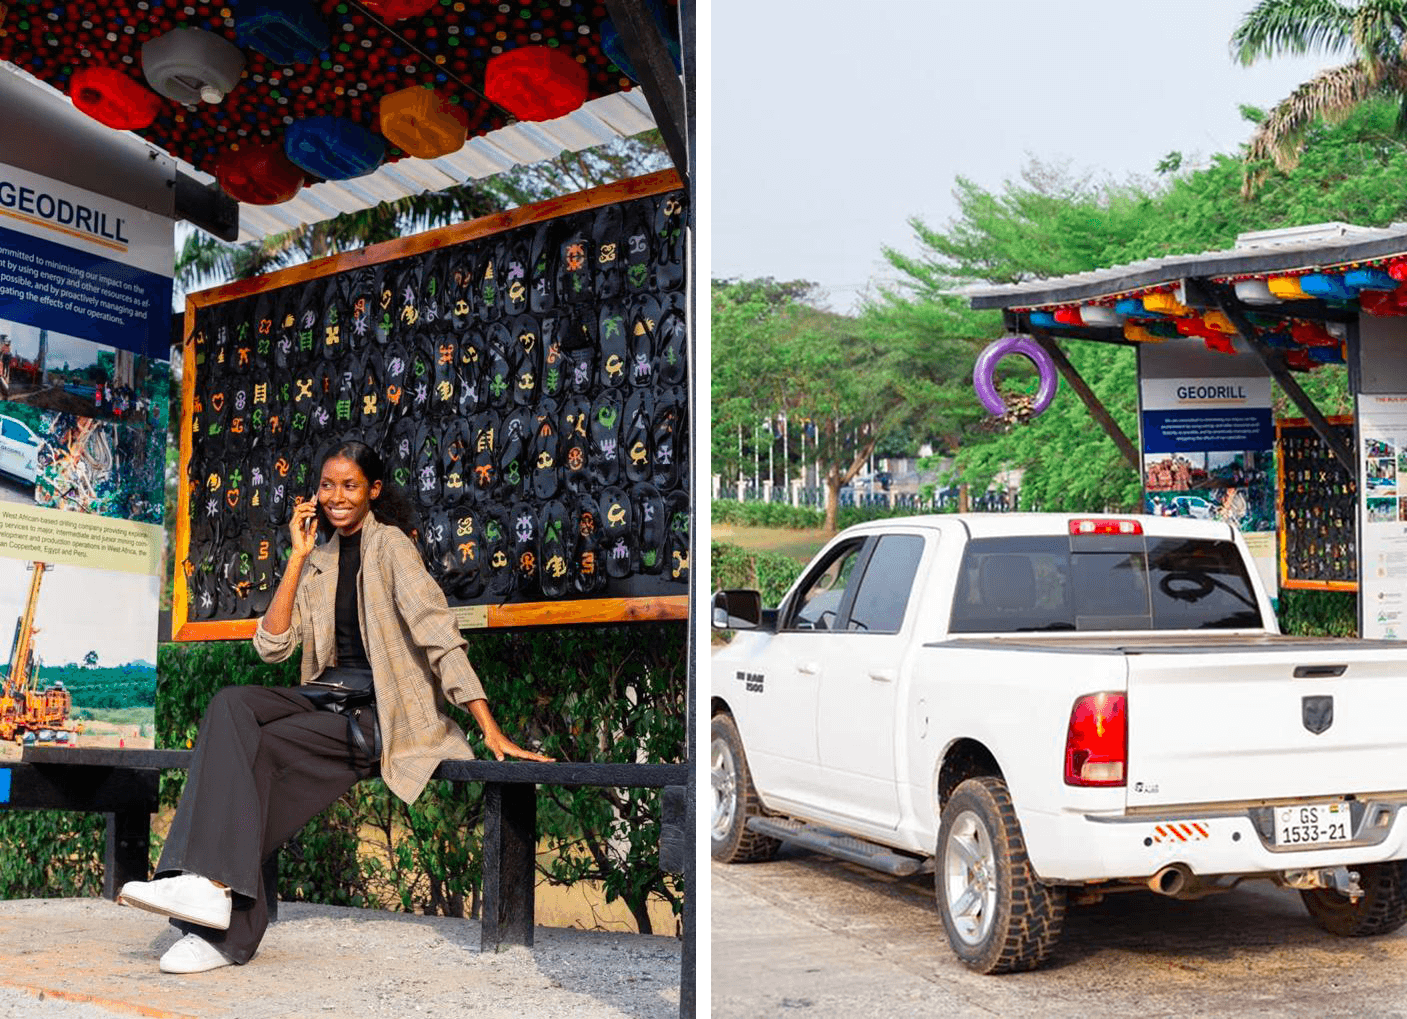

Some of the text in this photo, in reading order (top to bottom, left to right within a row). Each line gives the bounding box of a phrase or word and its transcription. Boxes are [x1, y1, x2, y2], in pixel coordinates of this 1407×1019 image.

[0, 181, 129, 244] GEODRILL
[7, 260, 17, 272] by
[18, 265, 39, 279] using
[40, 271, 66, 285] energy
[66, 278, 80, 289] and
[81, 282, 100, 294] other
[100, 288, 133, 304] resources
[36, 256, 44, 265] to
[45, 260, 84, 279] minimizing
[85, 271, 98, 280] our
[99, 274, 122, 288] impact
[123, 283, 132, 291] on
[133, 284, 144, 295] the
[1, 273, 148, 320] possible, and by proactively managing and
[26, 291, 39, 302] the
[40, 295, 64, 309] effects
[64, 302, 73, 310] of
[73, 305, 86, 314] our
[1177, 386, 1246, 399] GEODRILL
[1300, 807, 1318, 824] GS
[1283, 823, 1346, 843] 1533-21
